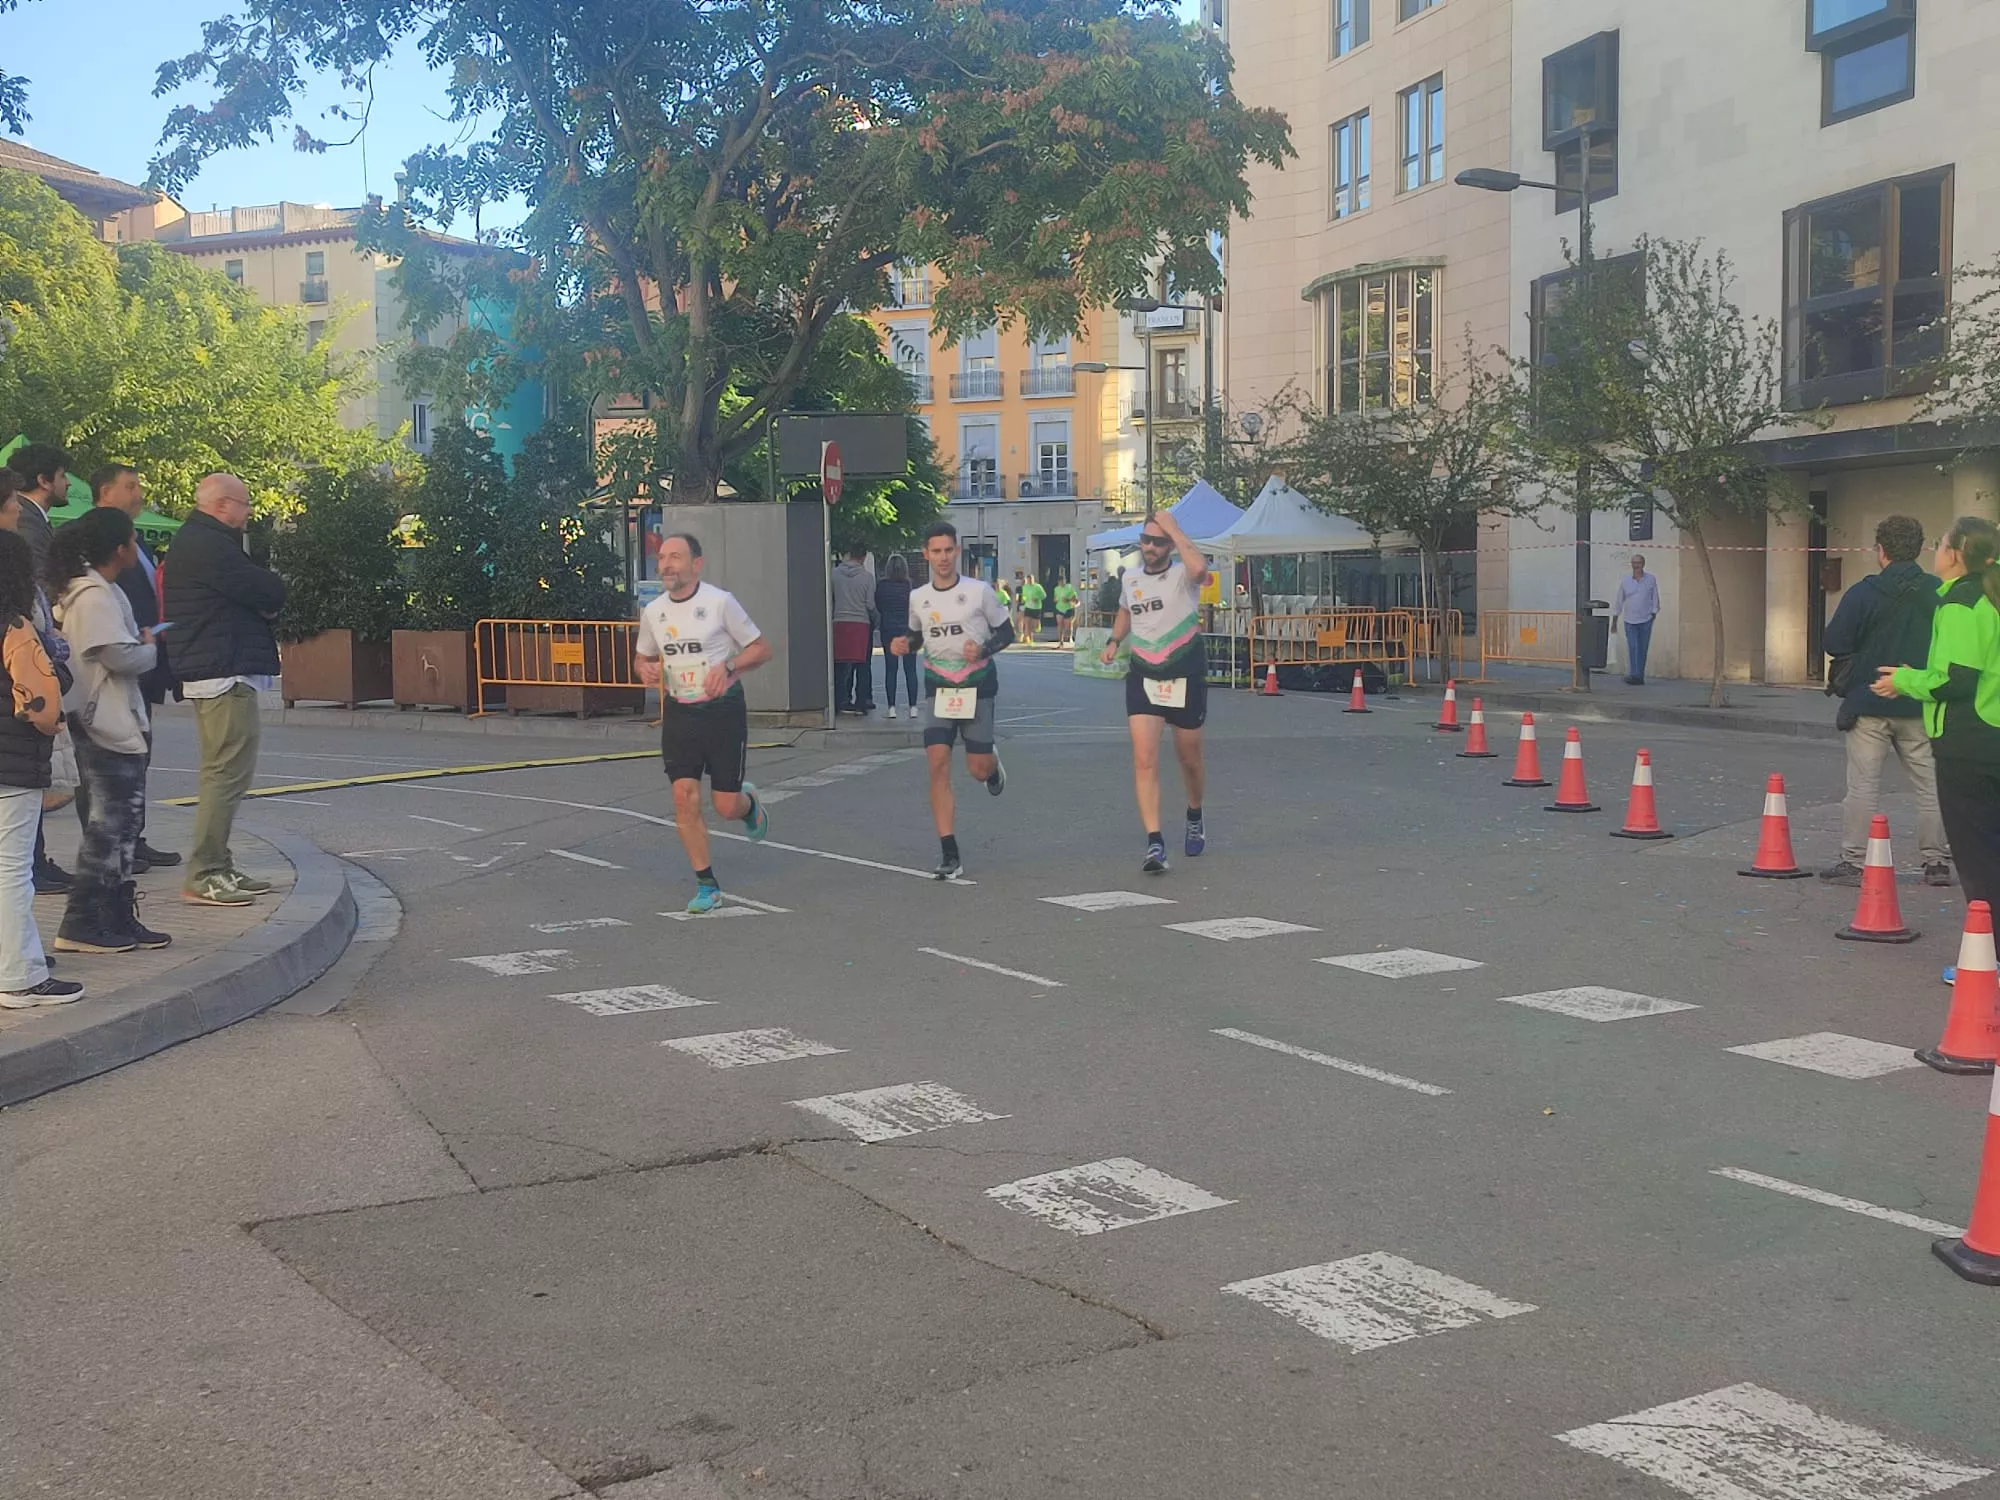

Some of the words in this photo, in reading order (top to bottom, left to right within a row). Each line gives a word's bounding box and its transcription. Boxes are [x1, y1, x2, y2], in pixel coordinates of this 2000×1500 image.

[1131, 600, 1164, 615] SYB
[930, 625, 963, 637] SYB
[664, 642, 702, 655] SYB
[680, 672, 695, 682] 17
[1157, 684, 1172, 694] 14
[948, 697, 963, 707] 23
